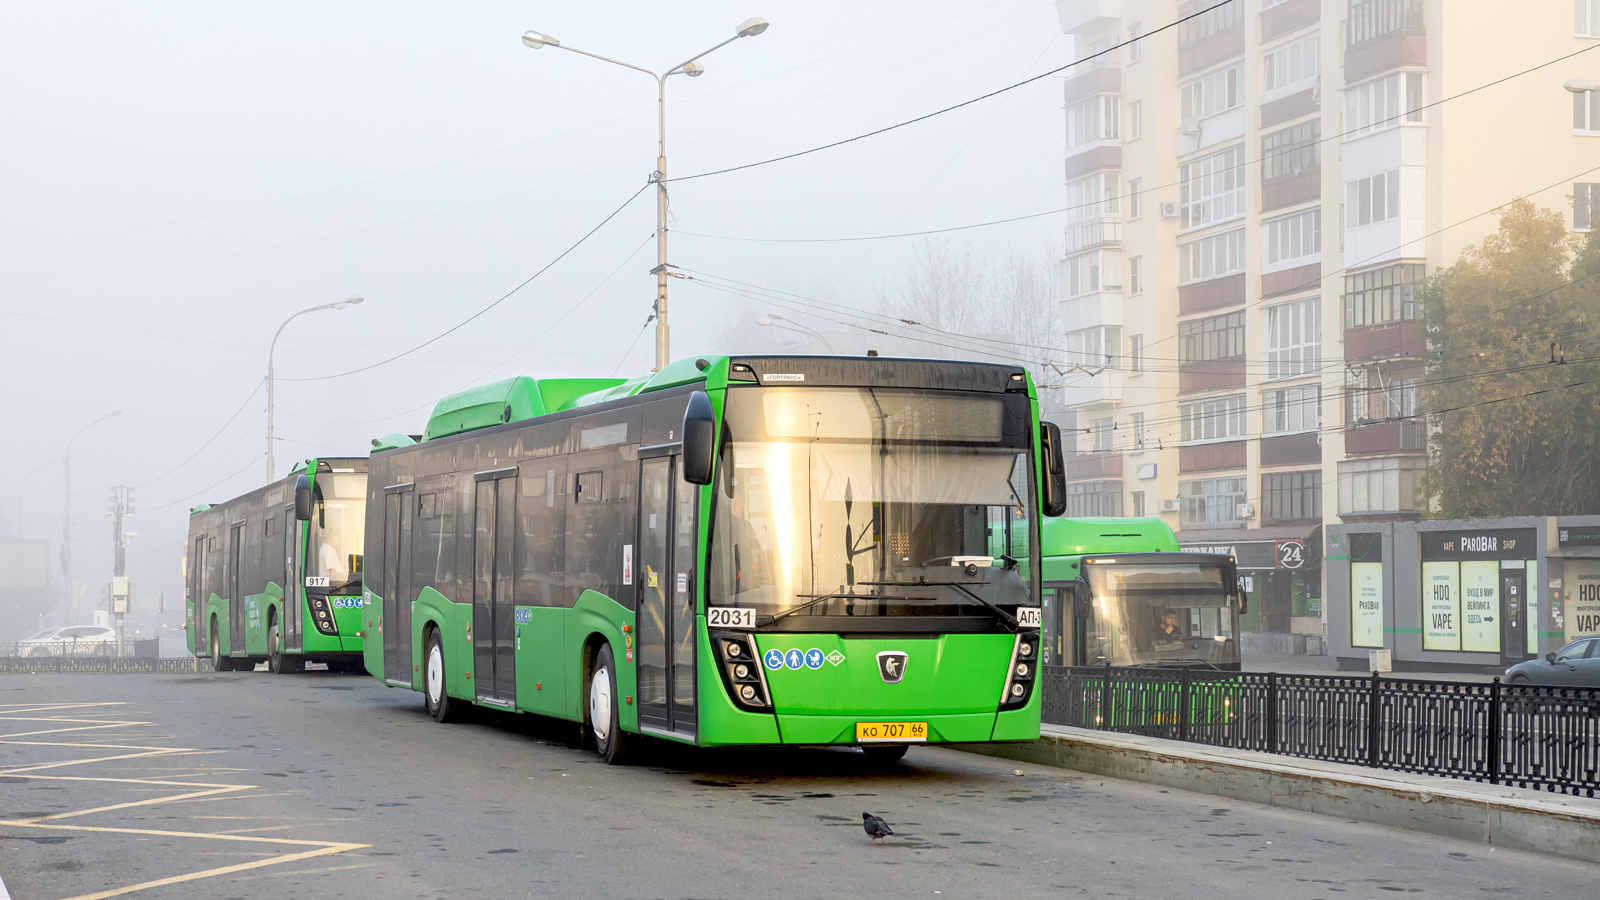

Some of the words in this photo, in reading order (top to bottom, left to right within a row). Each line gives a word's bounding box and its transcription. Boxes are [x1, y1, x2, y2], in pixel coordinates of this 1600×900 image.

[1443, 541, 1455, 551] VAPE
[1503, 539, 1516, 550] SHOP
[1282, 547, 1302, 562] 24
[309, 577, 325, 586] 917
[1433, 584, 1450, 601] HDQ
[1467, 588, 1480, 598] ВХОД
[1484, 588, 1494, 597] МИР
[1467, 600, 1491, 611] ВЕЙПИНГА
[710, 609, 751, 626] 2031
[1432, 613, 1453, 630] VAPE
[1467, 614, 1483, 624] ЗДЕСЬ
[882, 724, 905, 737] 707
[911, 723, 924, 733] 66
